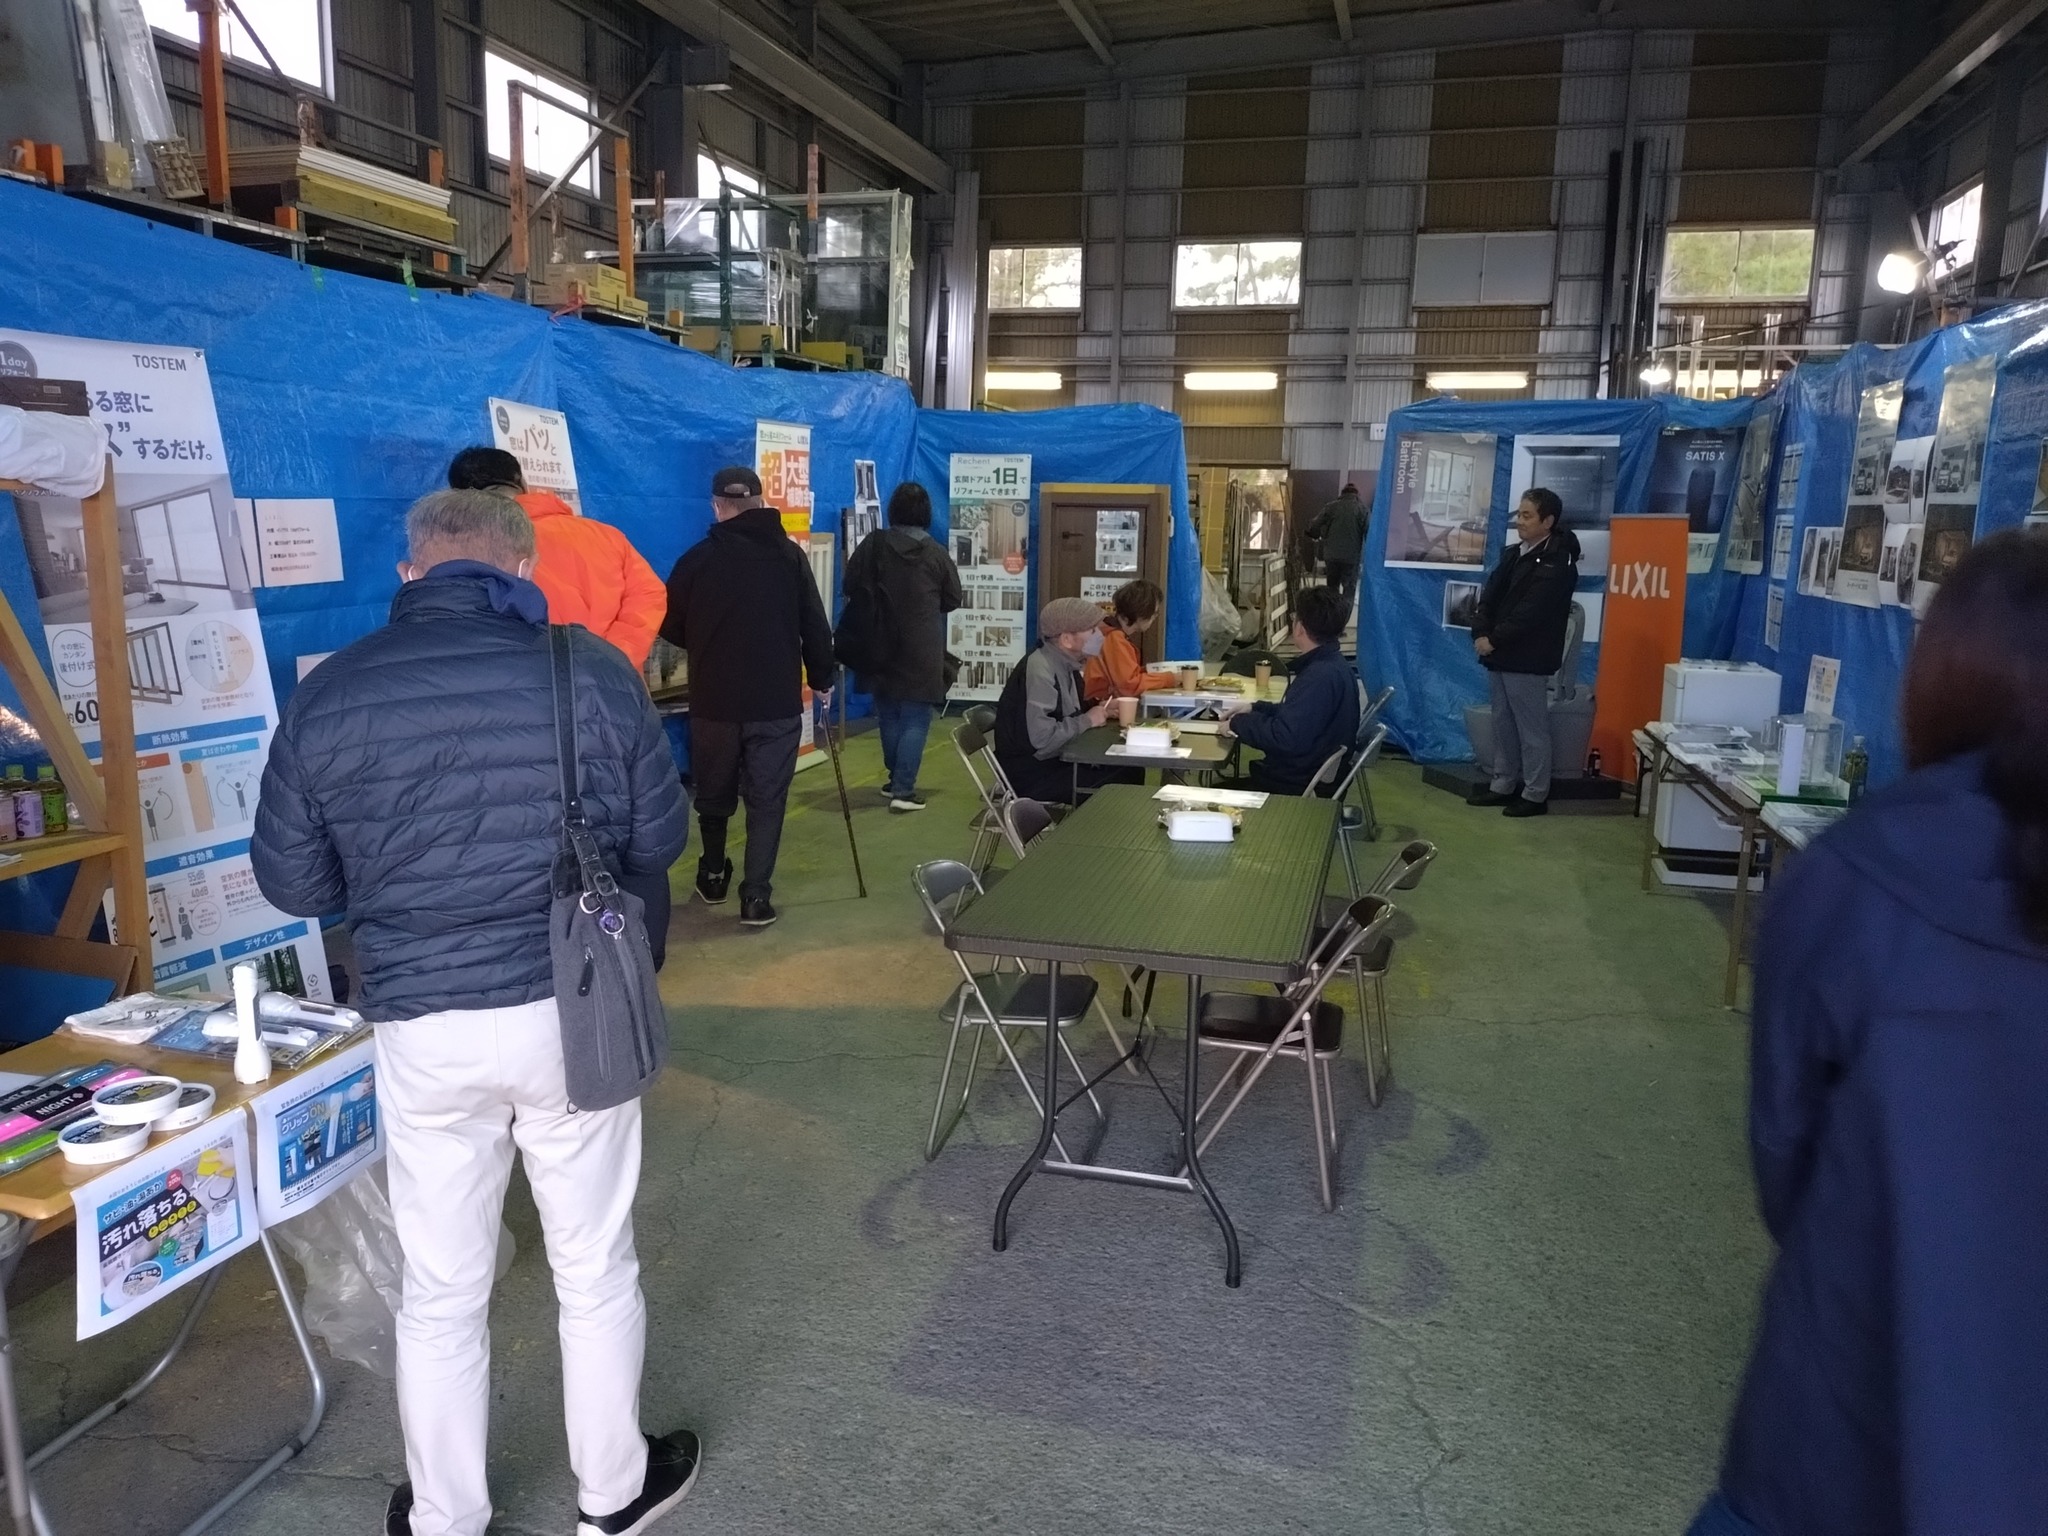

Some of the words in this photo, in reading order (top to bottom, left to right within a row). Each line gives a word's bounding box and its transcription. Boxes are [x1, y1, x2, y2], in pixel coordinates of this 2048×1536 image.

[132, 354, 187, 372] TOSTEM
[1408, 441, 1423, 488] Lifestyle
[1685, 451, 1717, 461] SATIS
[1718, 451, 1726, 461] X
[1396, 440, 1411, 494] Bathroom
[1609, 561, 1671, 600] LIXIL
[152, 731, 189, 746] 断熱効果
[245, 931, 286, 950] デザイン性
[35, 1095, 75, 1115] NIGHT
[101, 1188, 188, 1256] 汚れ落ちる
